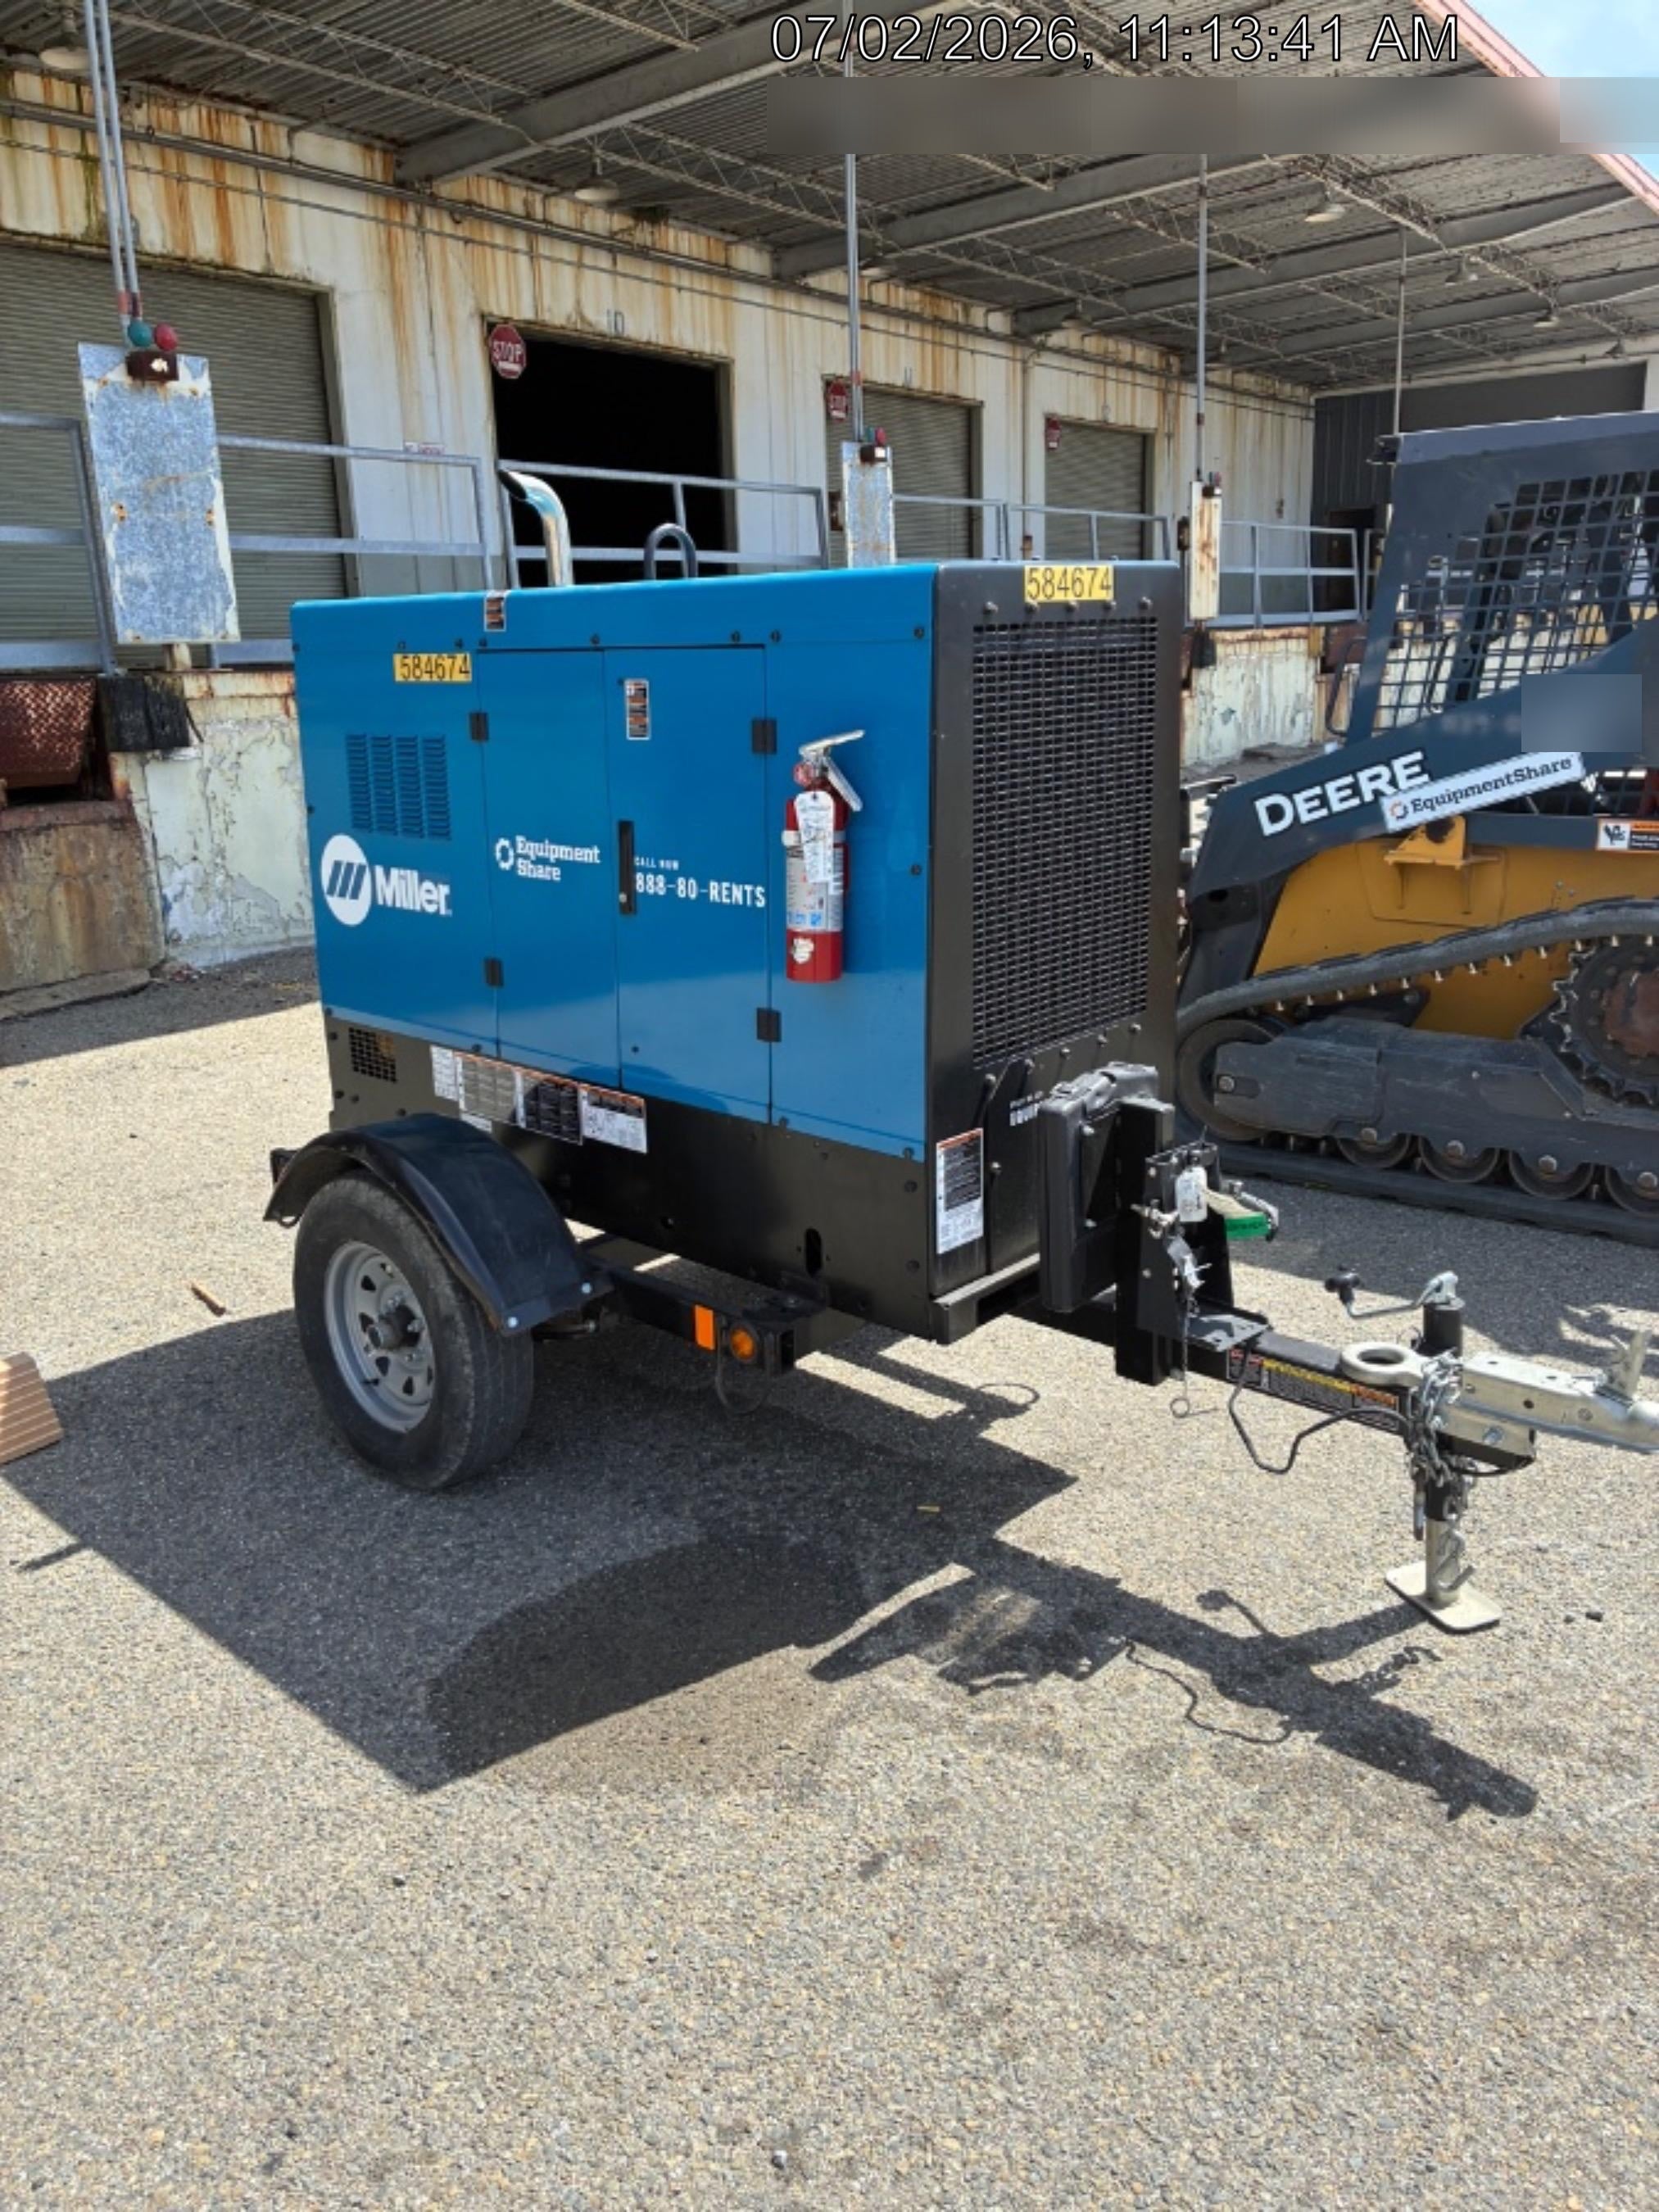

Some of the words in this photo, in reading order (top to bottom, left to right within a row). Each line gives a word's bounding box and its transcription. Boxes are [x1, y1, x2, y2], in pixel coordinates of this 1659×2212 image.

[493, 341, 523, 363] STOP
[1027, 566, 1112, 600] 584674
[400, 654, 470, 681] 584674
[1254, 750, 1430, 836] DEERE
[1411, 758, 1572, 813] EquipmentShare
[515, 835, 601, 864] Equipment
[634, 855, 656, 868] CALL
[517, 858, 561, 882] Share
[374, 864, 452, 916] Miller
[636, 872, 766, 908] 888-80-RENTS
